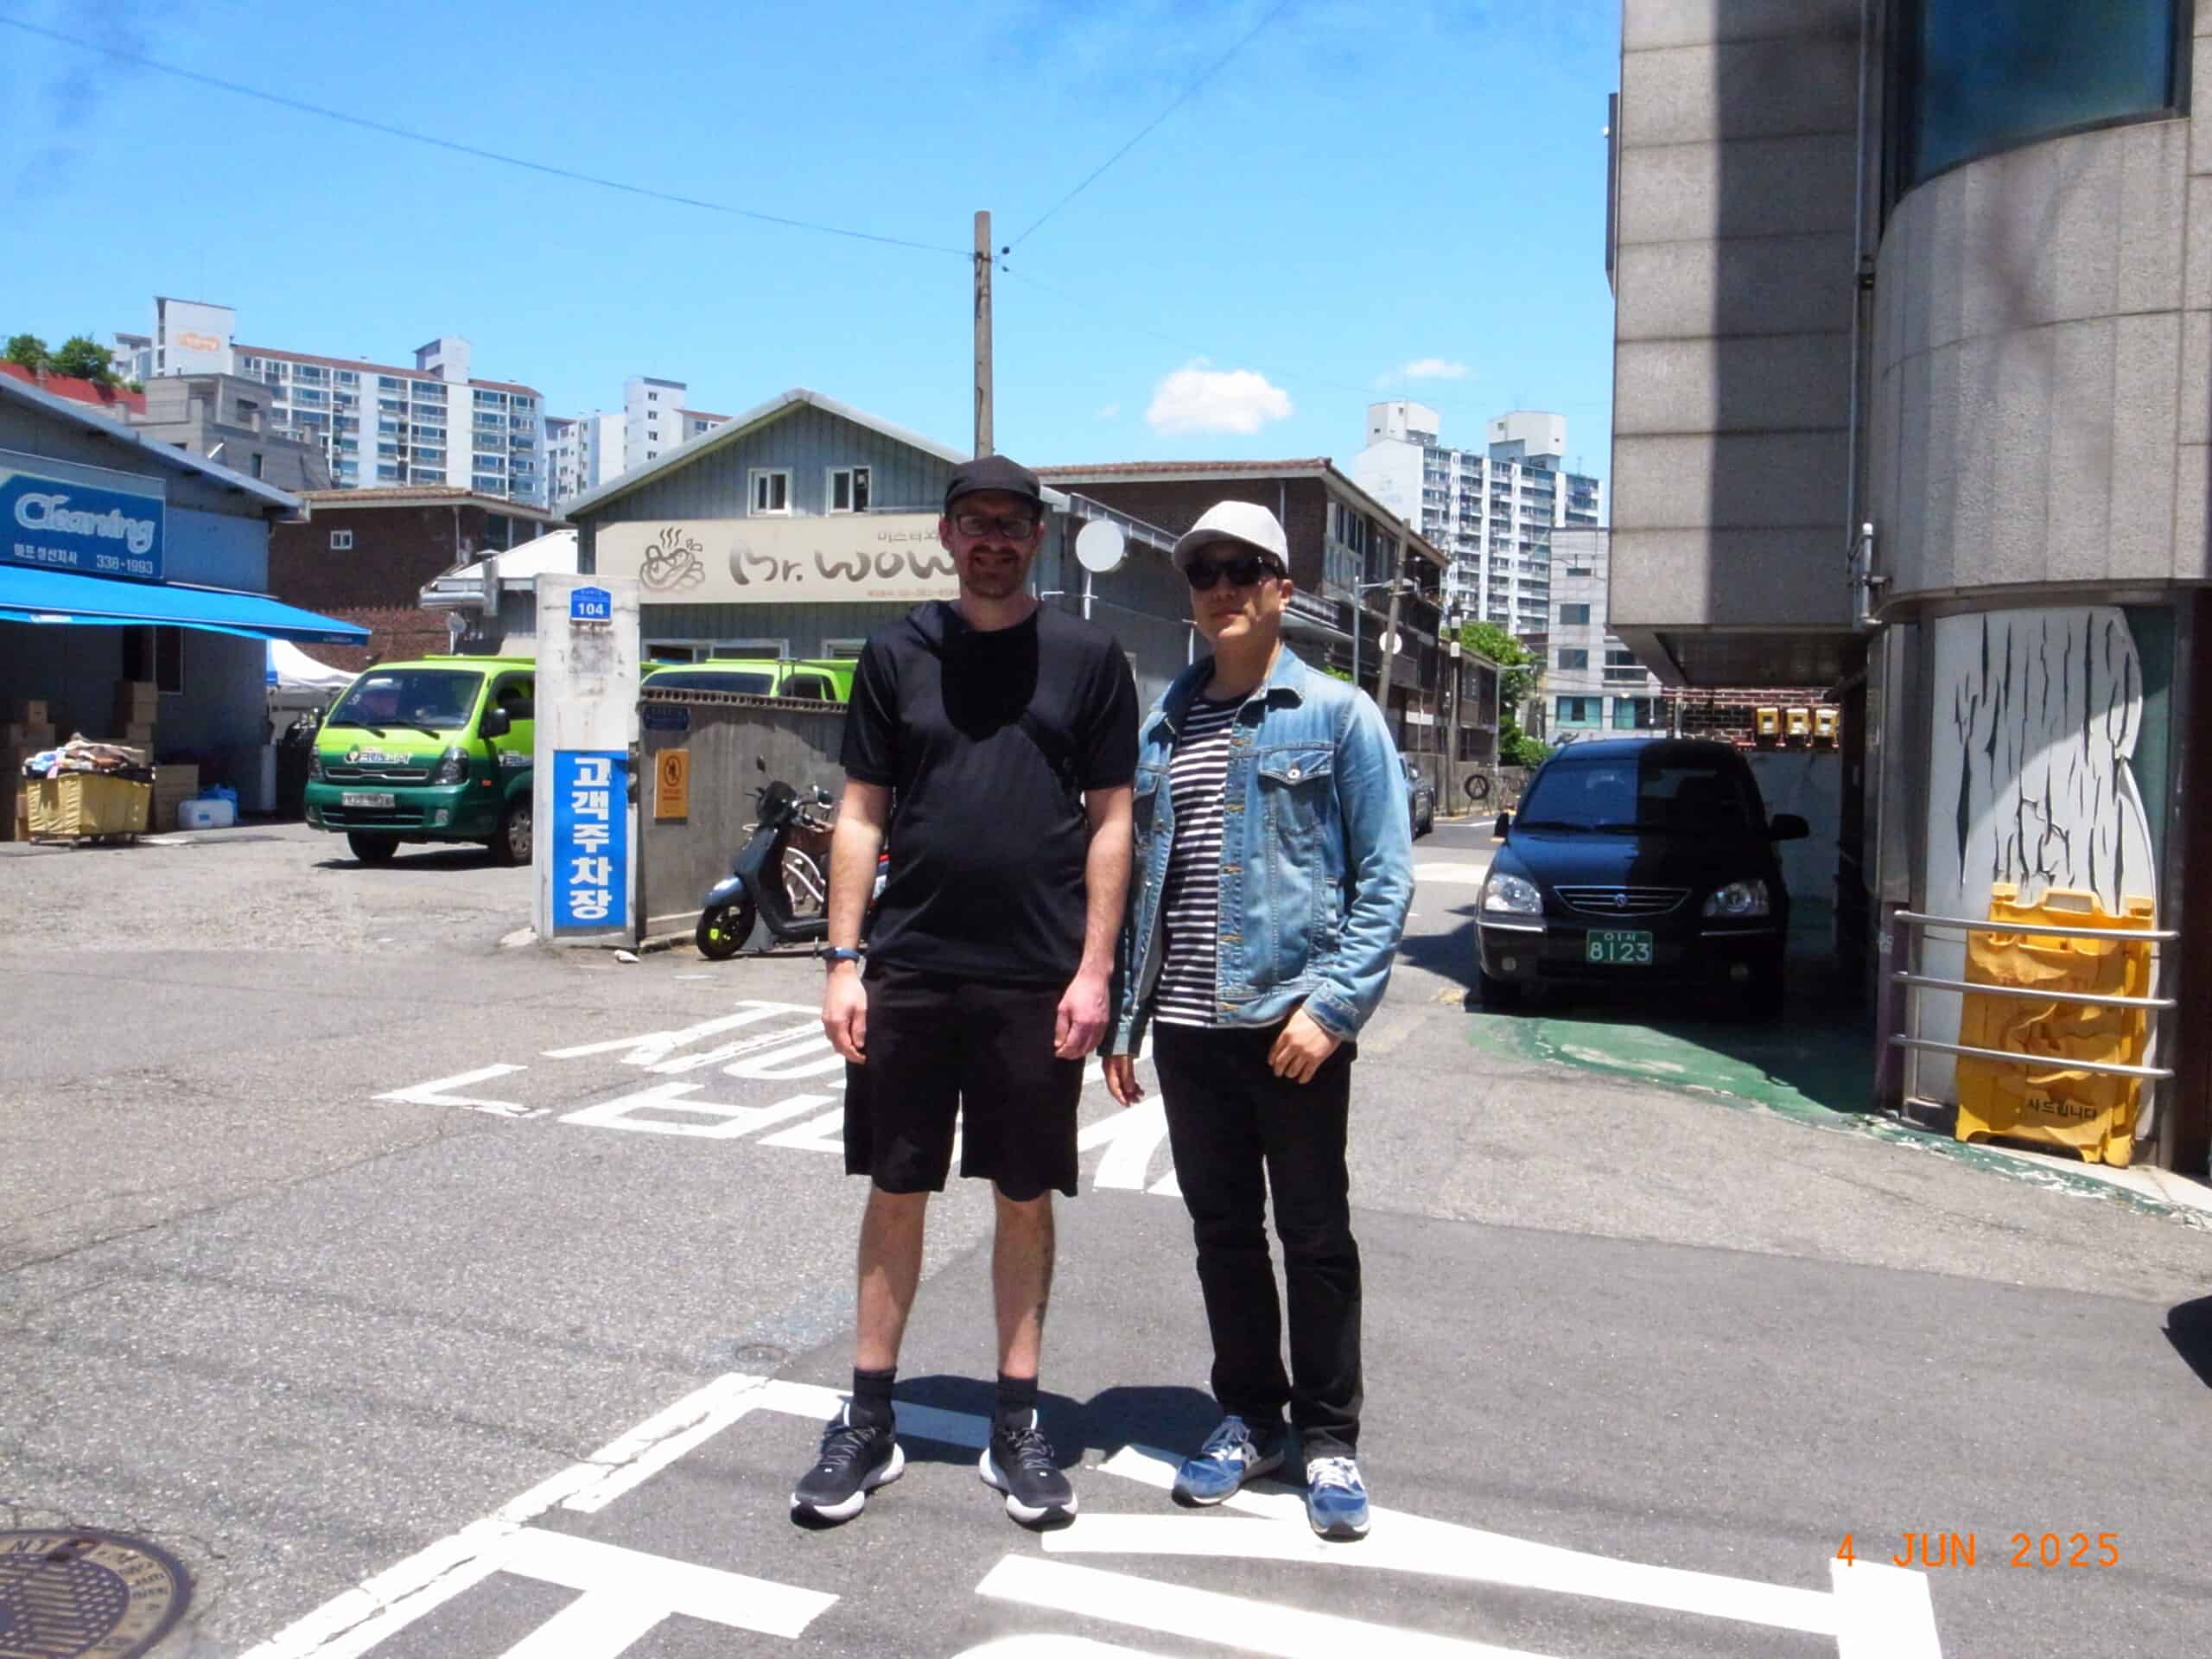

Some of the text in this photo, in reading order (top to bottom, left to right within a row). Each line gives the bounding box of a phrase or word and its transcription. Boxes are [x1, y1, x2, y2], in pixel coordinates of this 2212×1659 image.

[14, 492, 156, 555] Cleaning
[728, 546, 804, 586] Mr.
[577, 602, 604, 616] 104
[569, 757, 613, 921] 고객주차장
[1589, 942, 1650, 961] 8123
